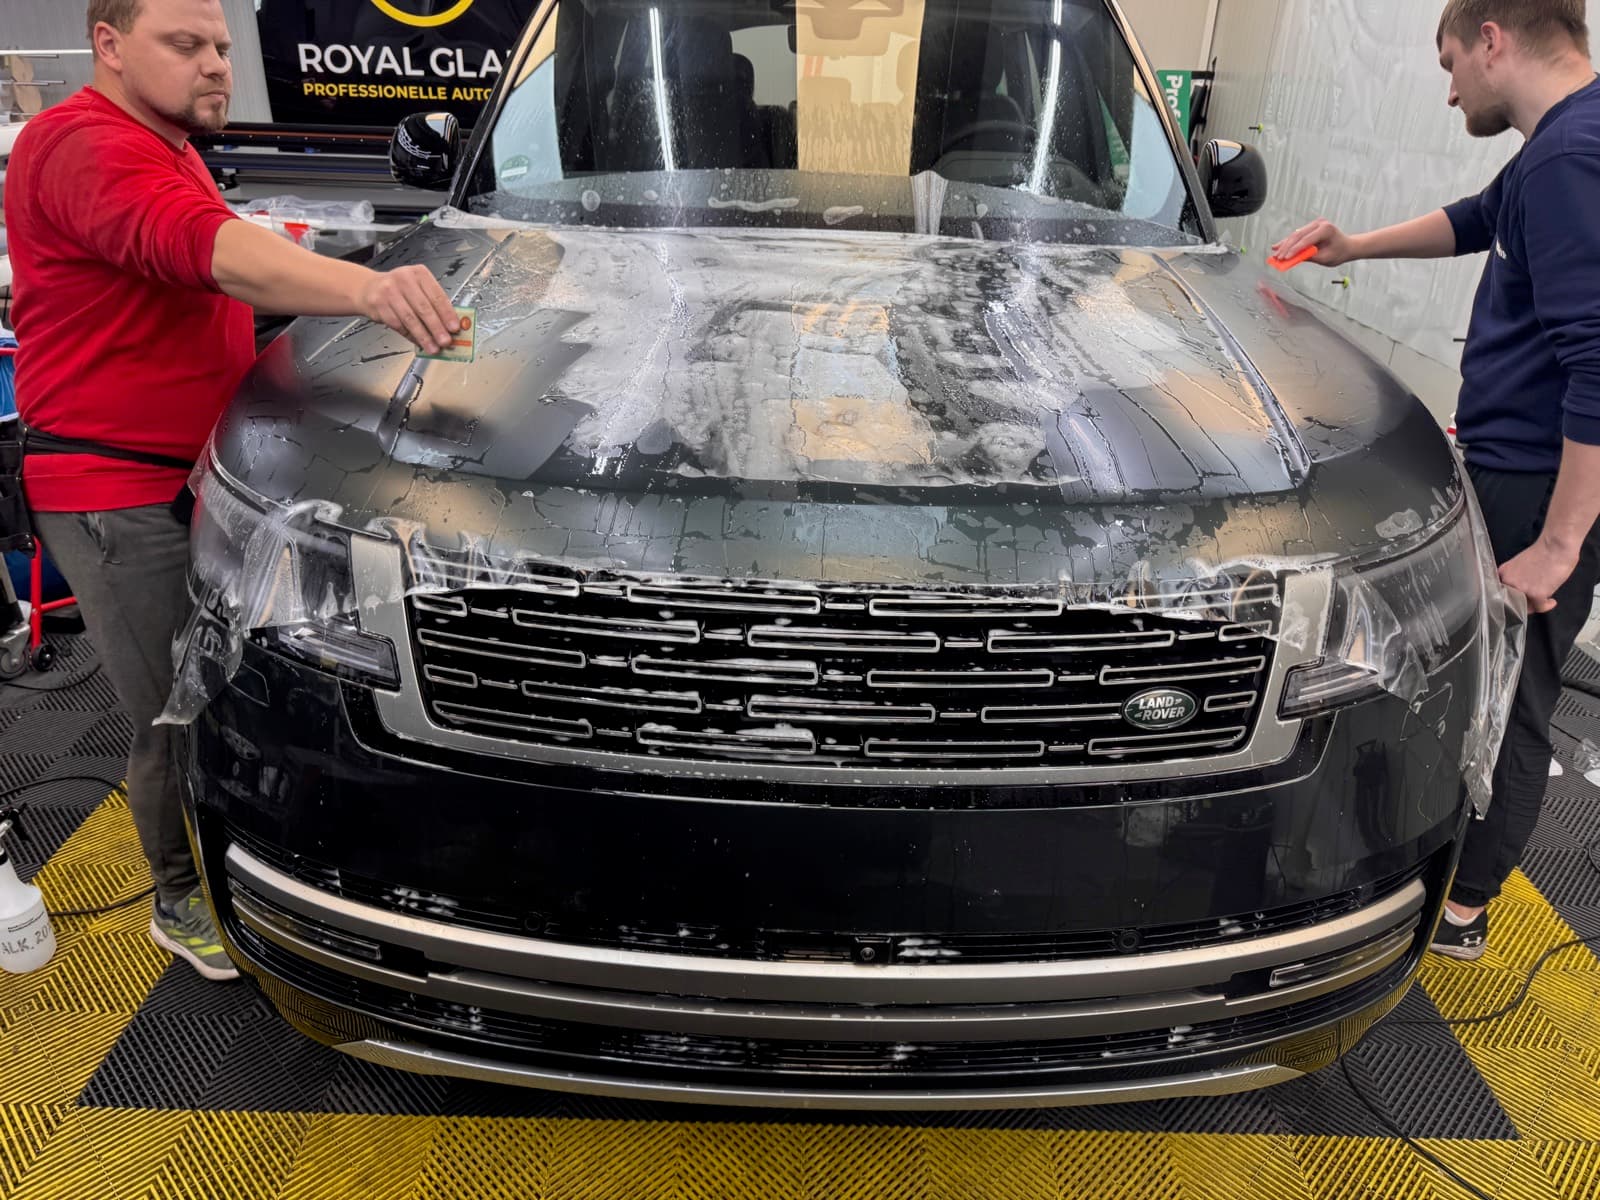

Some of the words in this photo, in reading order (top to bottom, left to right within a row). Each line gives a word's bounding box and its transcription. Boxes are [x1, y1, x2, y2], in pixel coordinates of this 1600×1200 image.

[298, 43, 424, 76] ROYAL
[429, 47, 511, 78] GLA
[303, 83, 447, 99] PROFESSIONELLE
[1166, 75, 1183, 126] Prof
[1139, 696, 1175, 709] LAND
[1141, 706, 1185, 720] ROVER
[34, 922, 51, 945] 20
